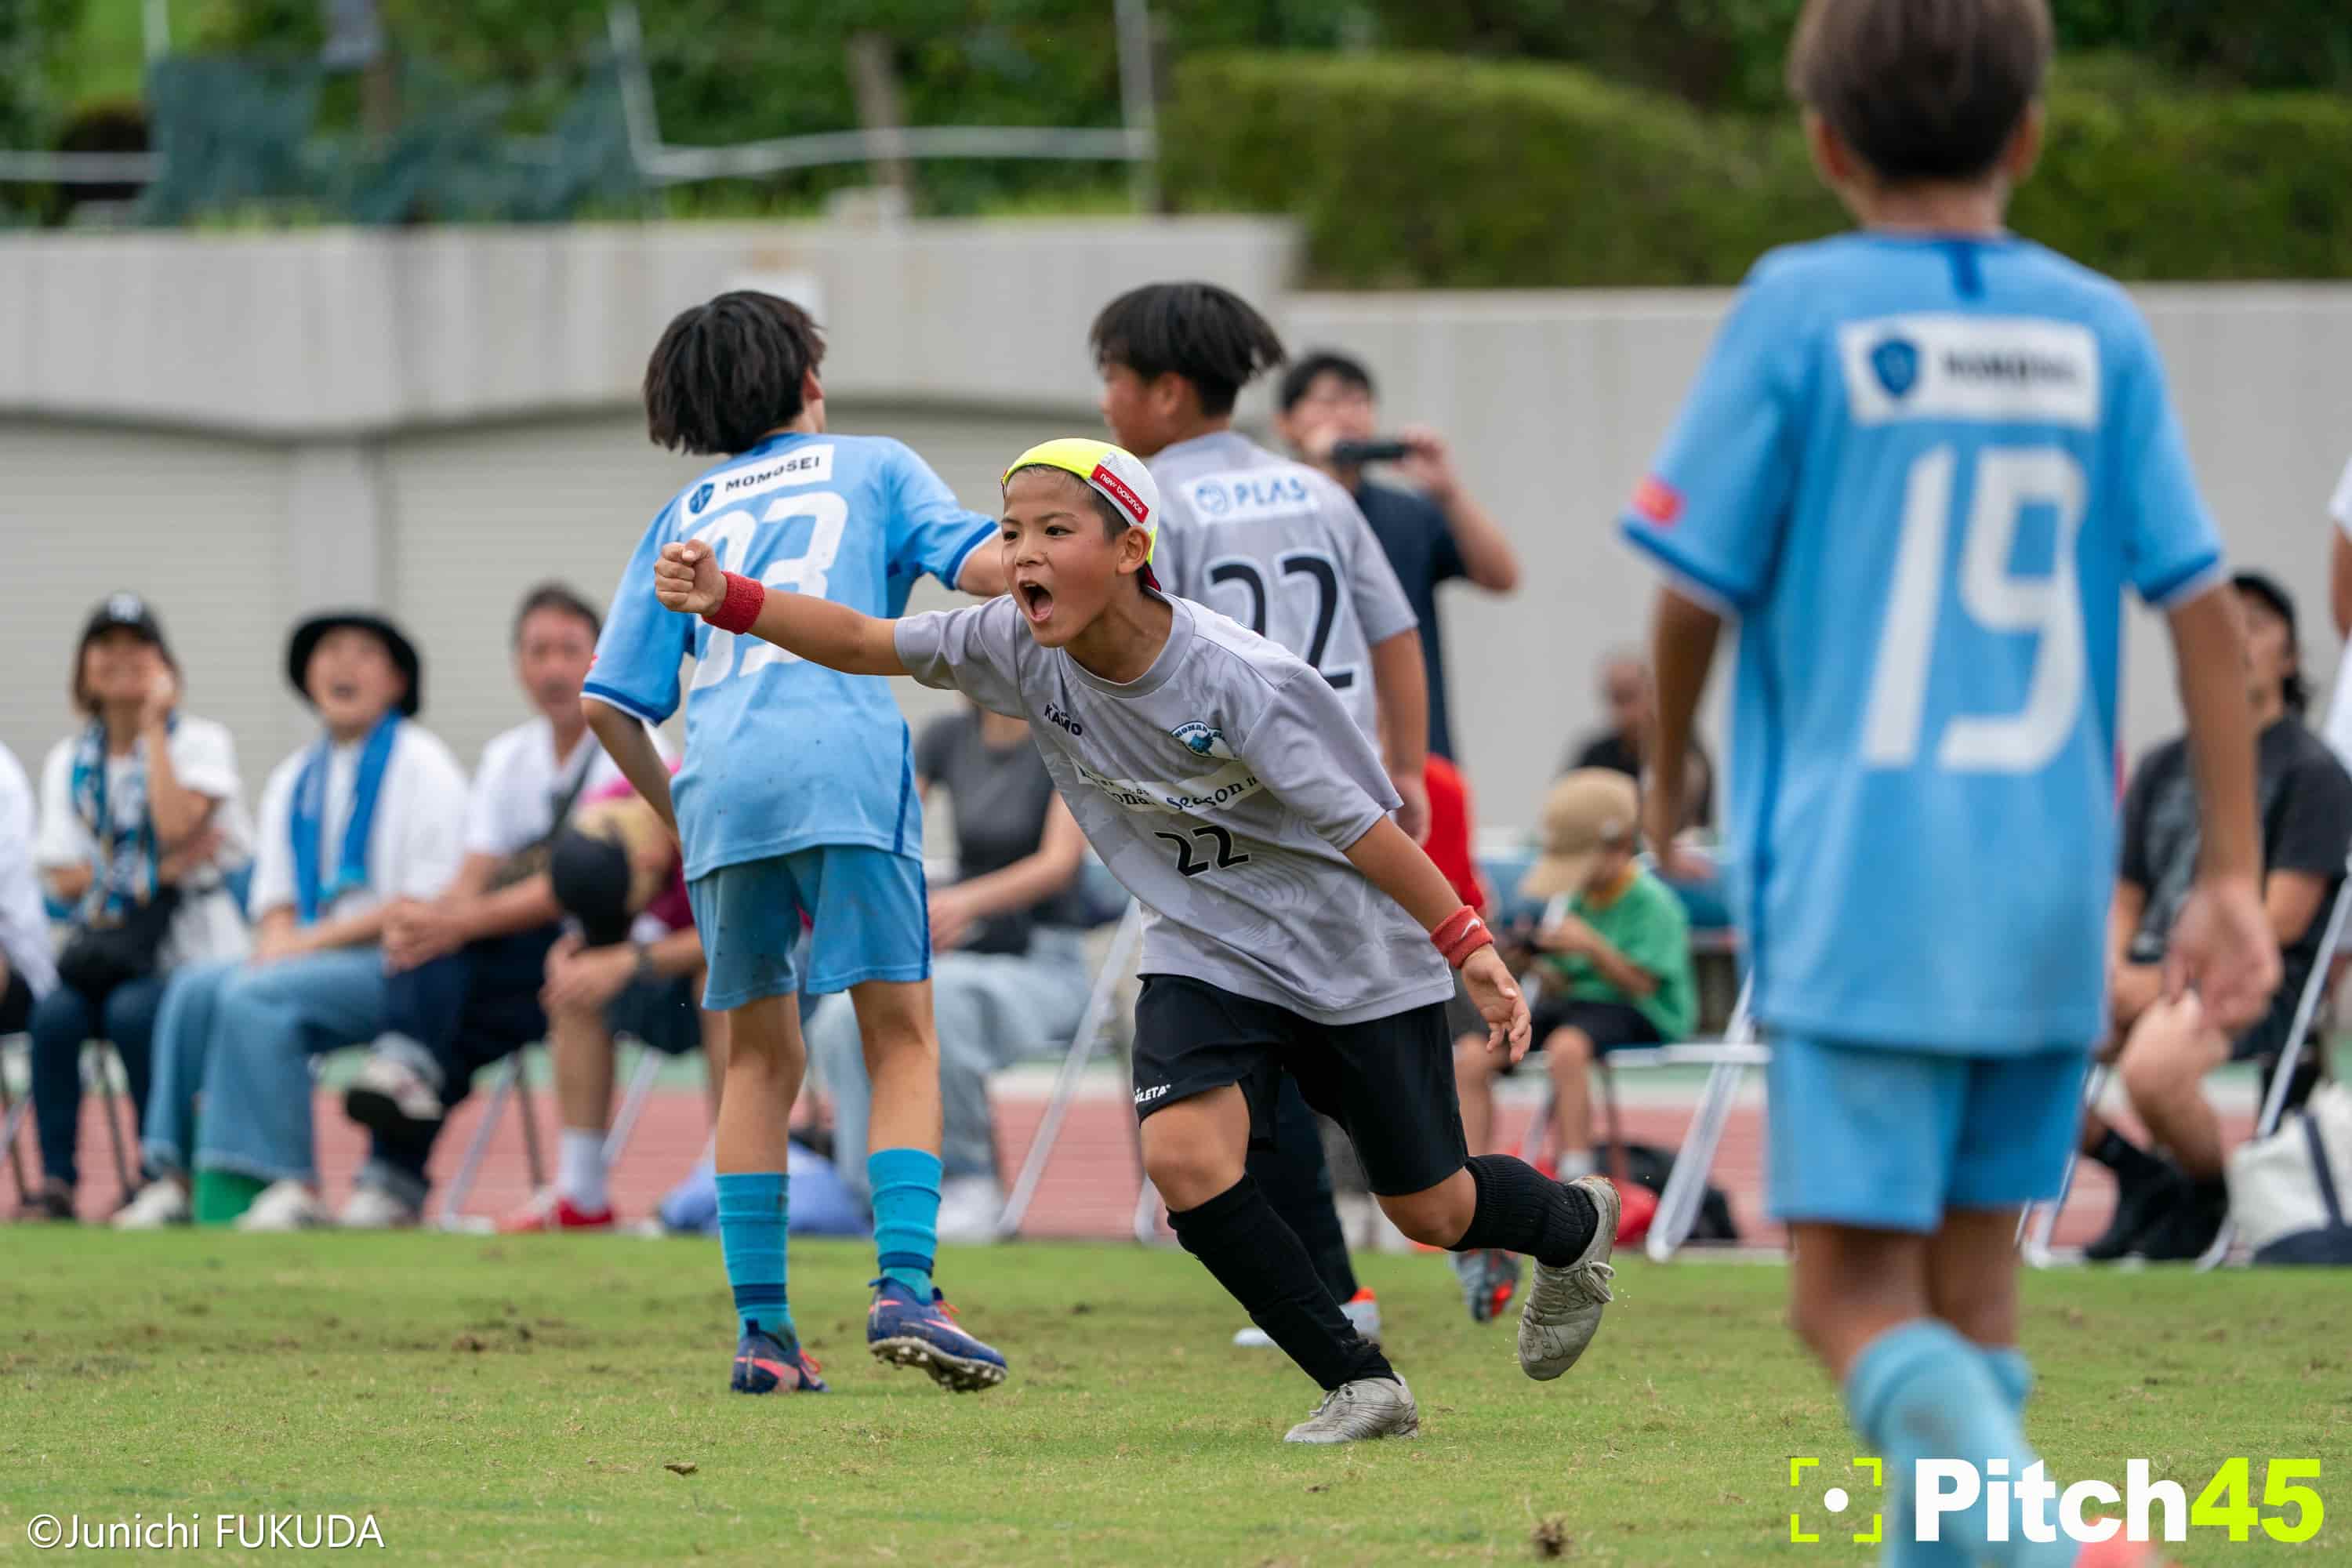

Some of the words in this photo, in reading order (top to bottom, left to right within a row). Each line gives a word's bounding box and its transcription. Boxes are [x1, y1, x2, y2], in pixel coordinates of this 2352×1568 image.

[1099, 473, 1117, 488] new
[1116, 485, 1143, 514] balance
[1209, 554, 1356, 690] 22
[1862, 444, 2089, 770] 19
[1154, 825, 1250, 877] 22
